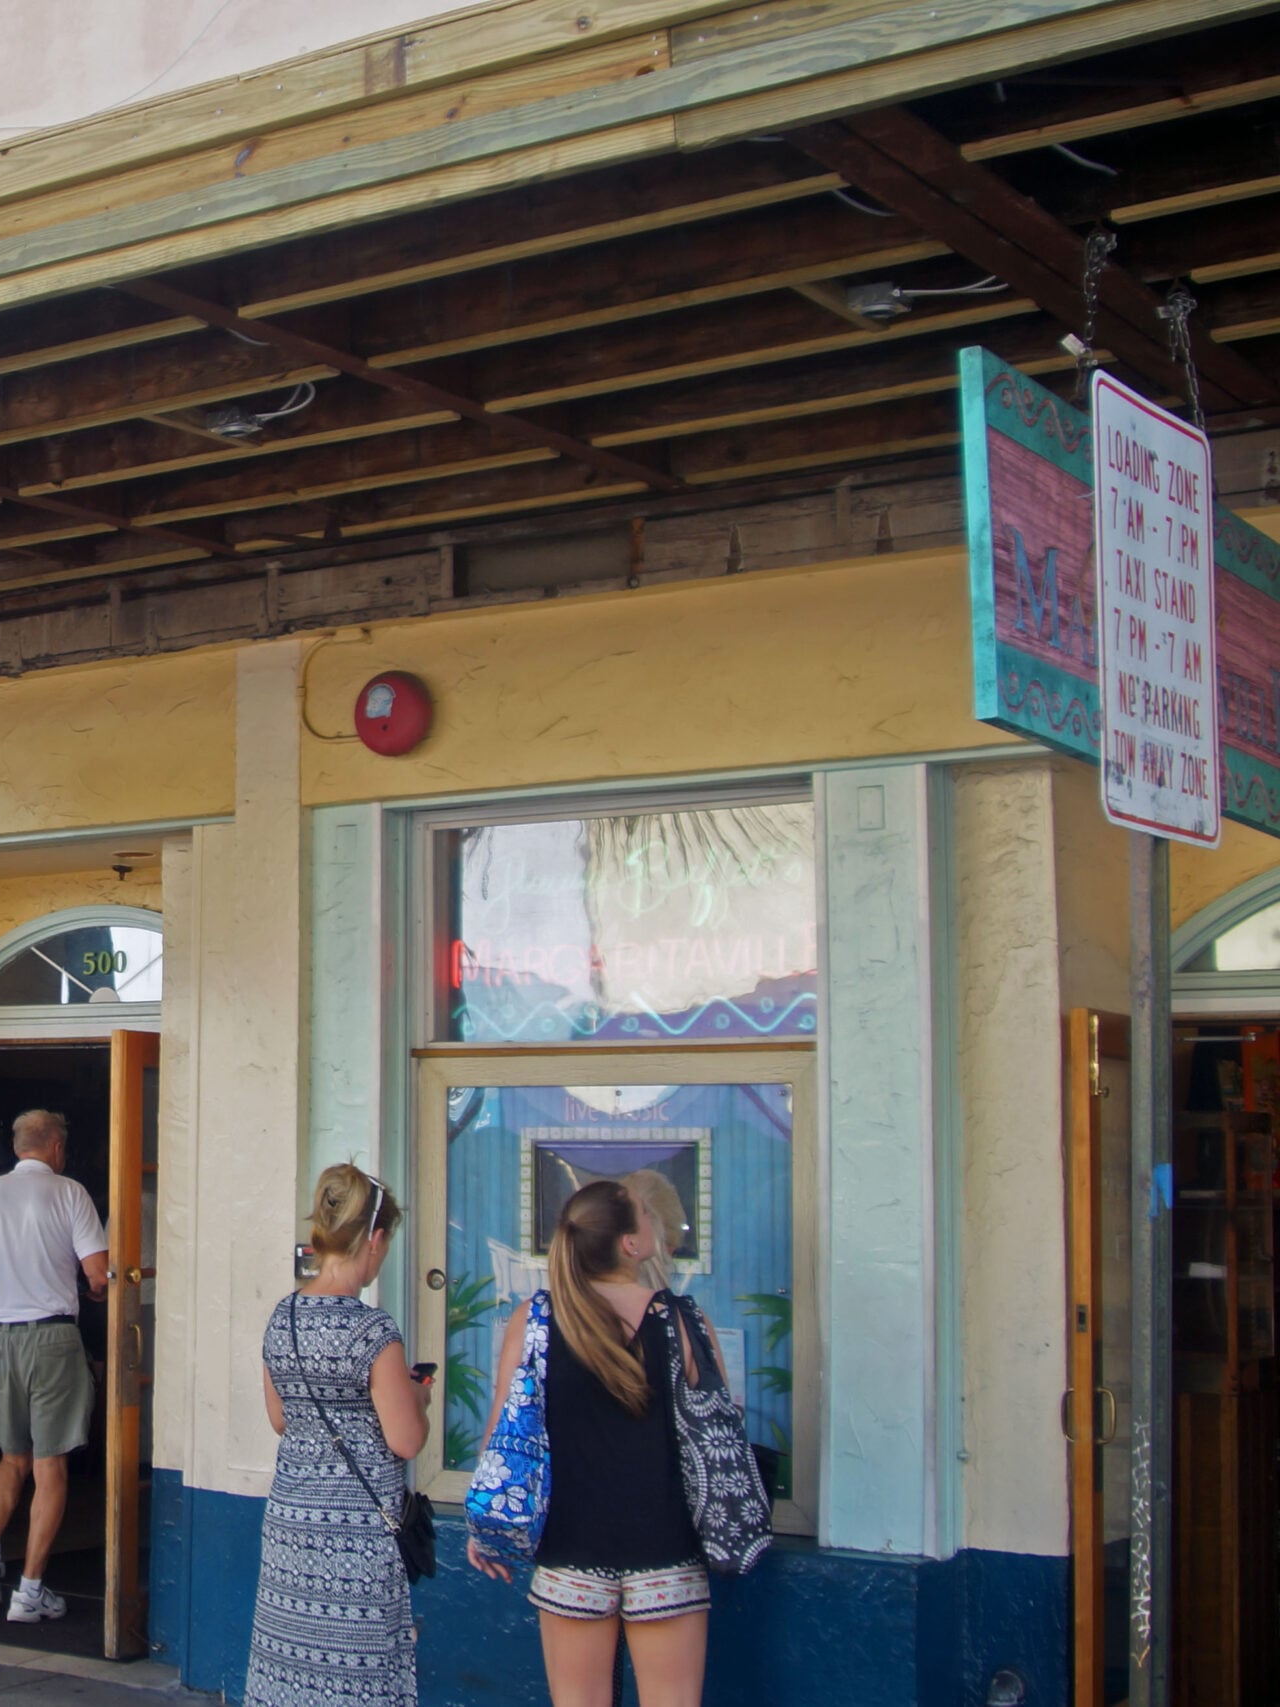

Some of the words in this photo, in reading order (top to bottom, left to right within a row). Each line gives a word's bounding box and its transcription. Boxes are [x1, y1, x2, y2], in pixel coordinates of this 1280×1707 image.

[1107, 425, 1159, 494] LOADING
[1168, 460, 1199, 514] ZONE
[1111, 486, 1118, 530] 7
[1127, 495, 1145, 545] AM
[1165, 515, 1173, 557] 7
[1181, 523, 1199, 571] PM
[1116, 548, 1146, 603] TAXI
[1154, 567, 1196, 624] STAND
[1113, 607, 1121, 651] 7
[1129, 613, 1147, 663] PM
[1167, 631, 1175, 674] 7
[1183, 638, 1202, 684] AM
[1118, 669, 1136, 718] NO
[1143, 680, 1200, 740] PARKING
[1113, 728, 1136, 778] TOW
[1143, 738, 1174, 789] AWAY
[1180, 751, 1209, 800] ZONE
[82, 950, 127, 975] 500
[563, 1096, 598, 1123] live
